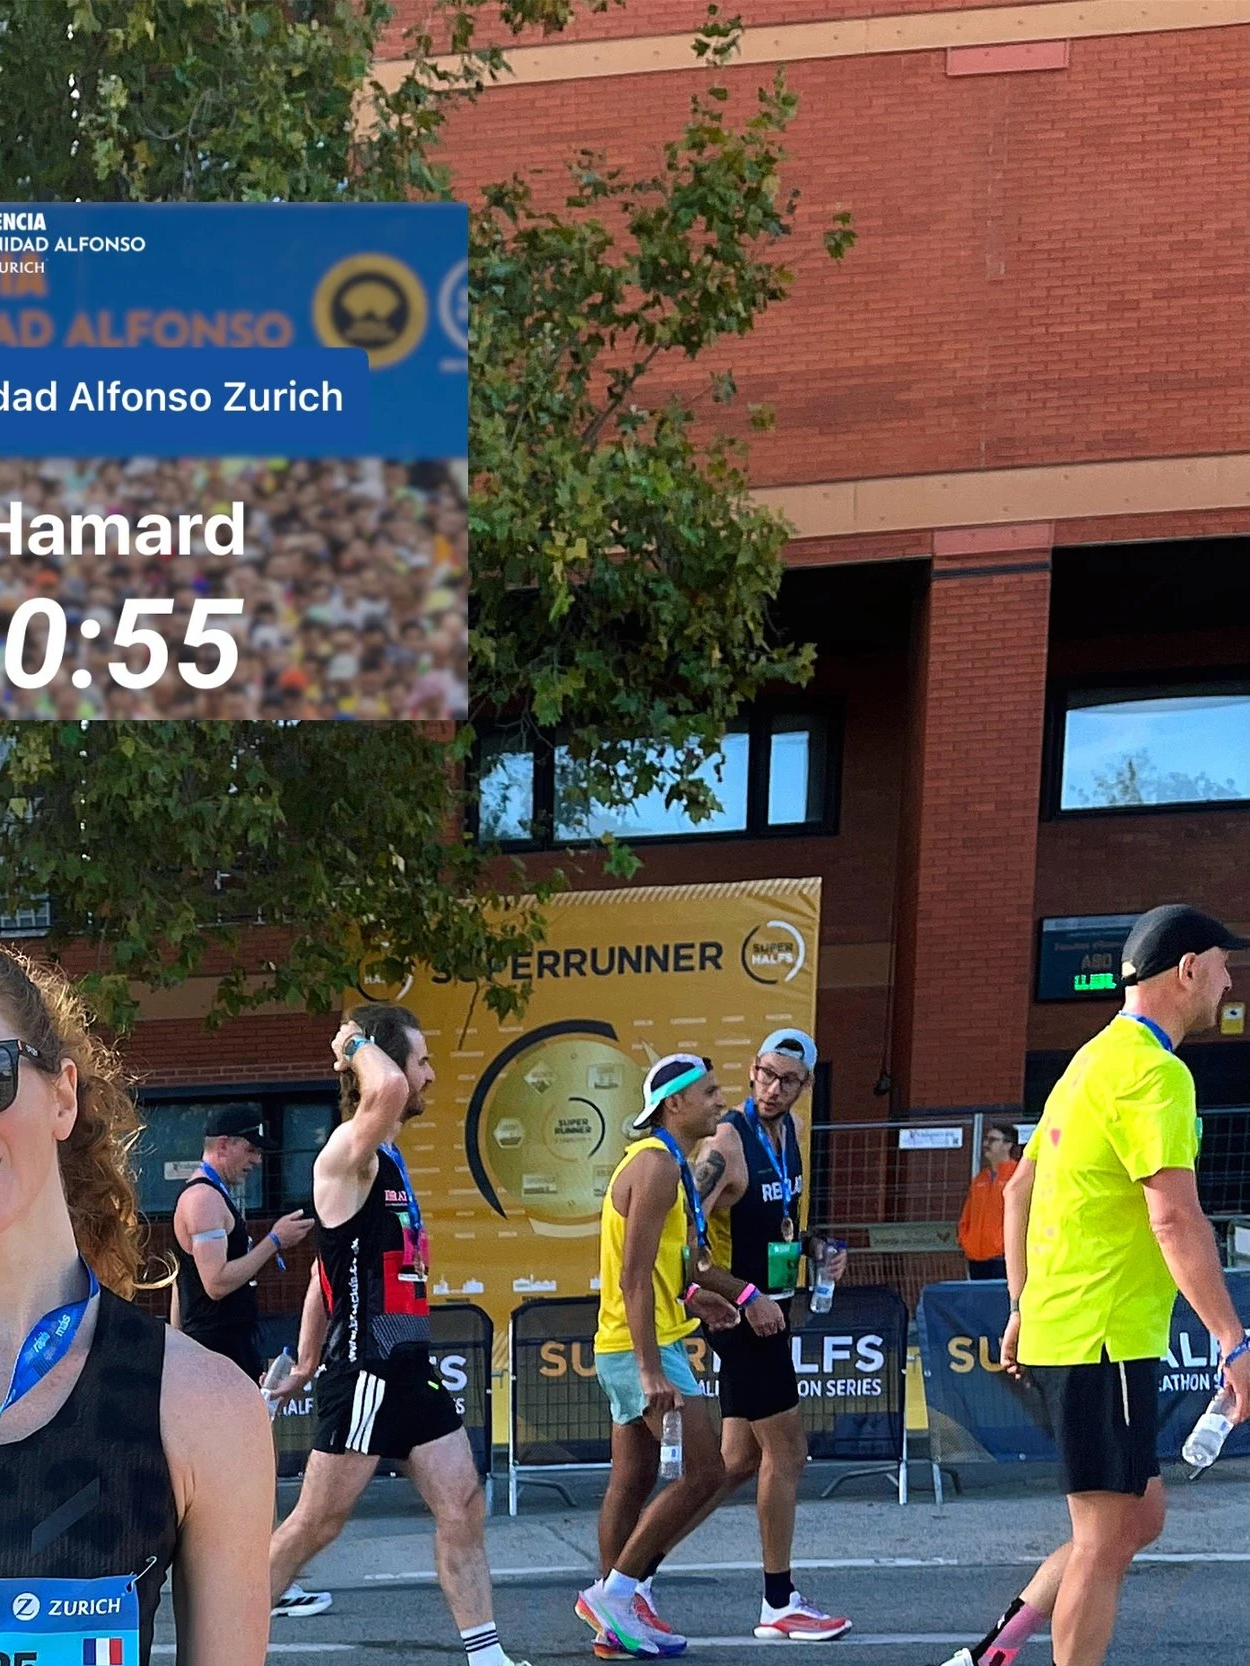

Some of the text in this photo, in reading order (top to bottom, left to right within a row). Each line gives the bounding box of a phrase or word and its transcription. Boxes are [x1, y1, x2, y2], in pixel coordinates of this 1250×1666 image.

[752, 942, 794, 953] SUPER
[751, 952, 794, 965] HALFS
[825, 1378, 882, 1398] SERIES
[48, 1597, 121, 1617] ZURICH
